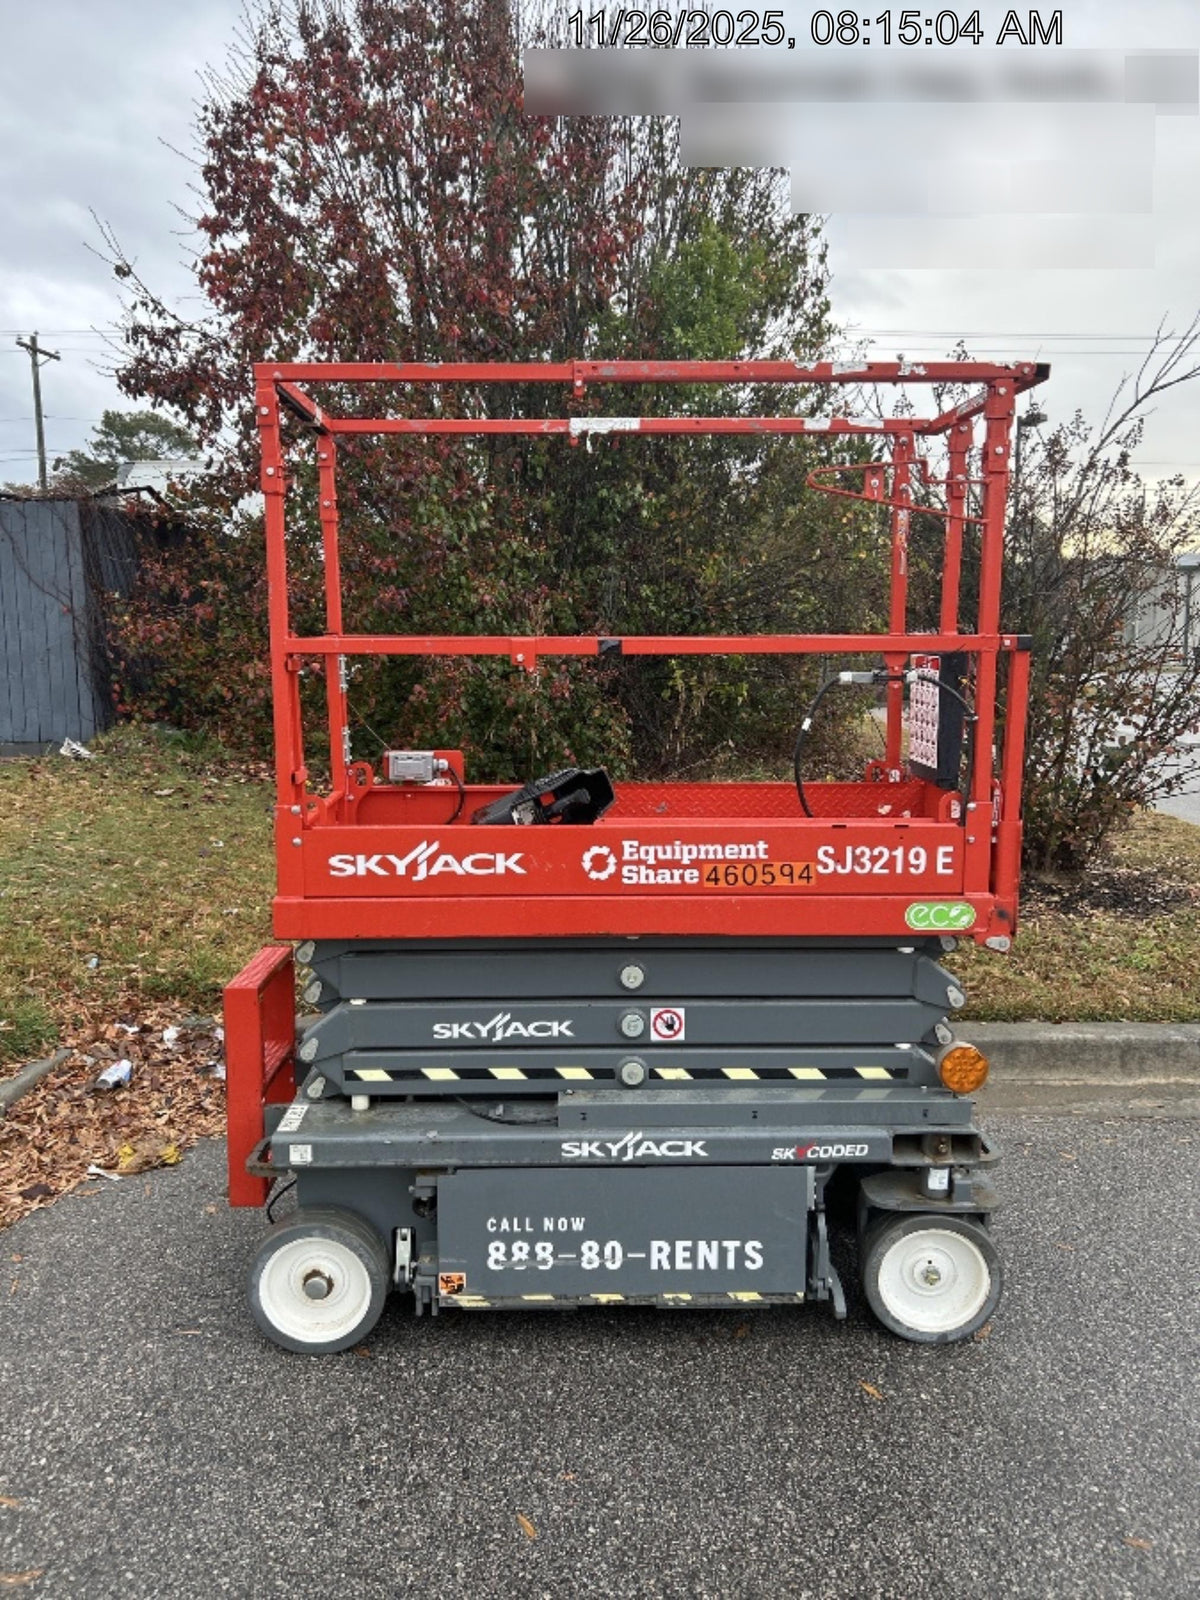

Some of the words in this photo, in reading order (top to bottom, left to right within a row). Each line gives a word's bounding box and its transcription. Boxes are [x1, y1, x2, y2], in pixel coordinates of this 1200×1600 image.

[328, 840, 527, 881] SKYJACK
[621, 840, 769, 863] Equipment
[816, 845, 927, 875] SJ3219
[936, 846, 954, 875] E
[621, 866, 700, 885] Share
[705, 863, 813, 886] 460594
[432, 1011, 575, 1042] SKYJACK
[560, 1130, 709, 1162] SKYJACK
[486, 1217, 534, 1233] CALL
[543, 1217, 586, 1232] NOW
[486, 1240, 765, 1271] 888-80-RENTS
